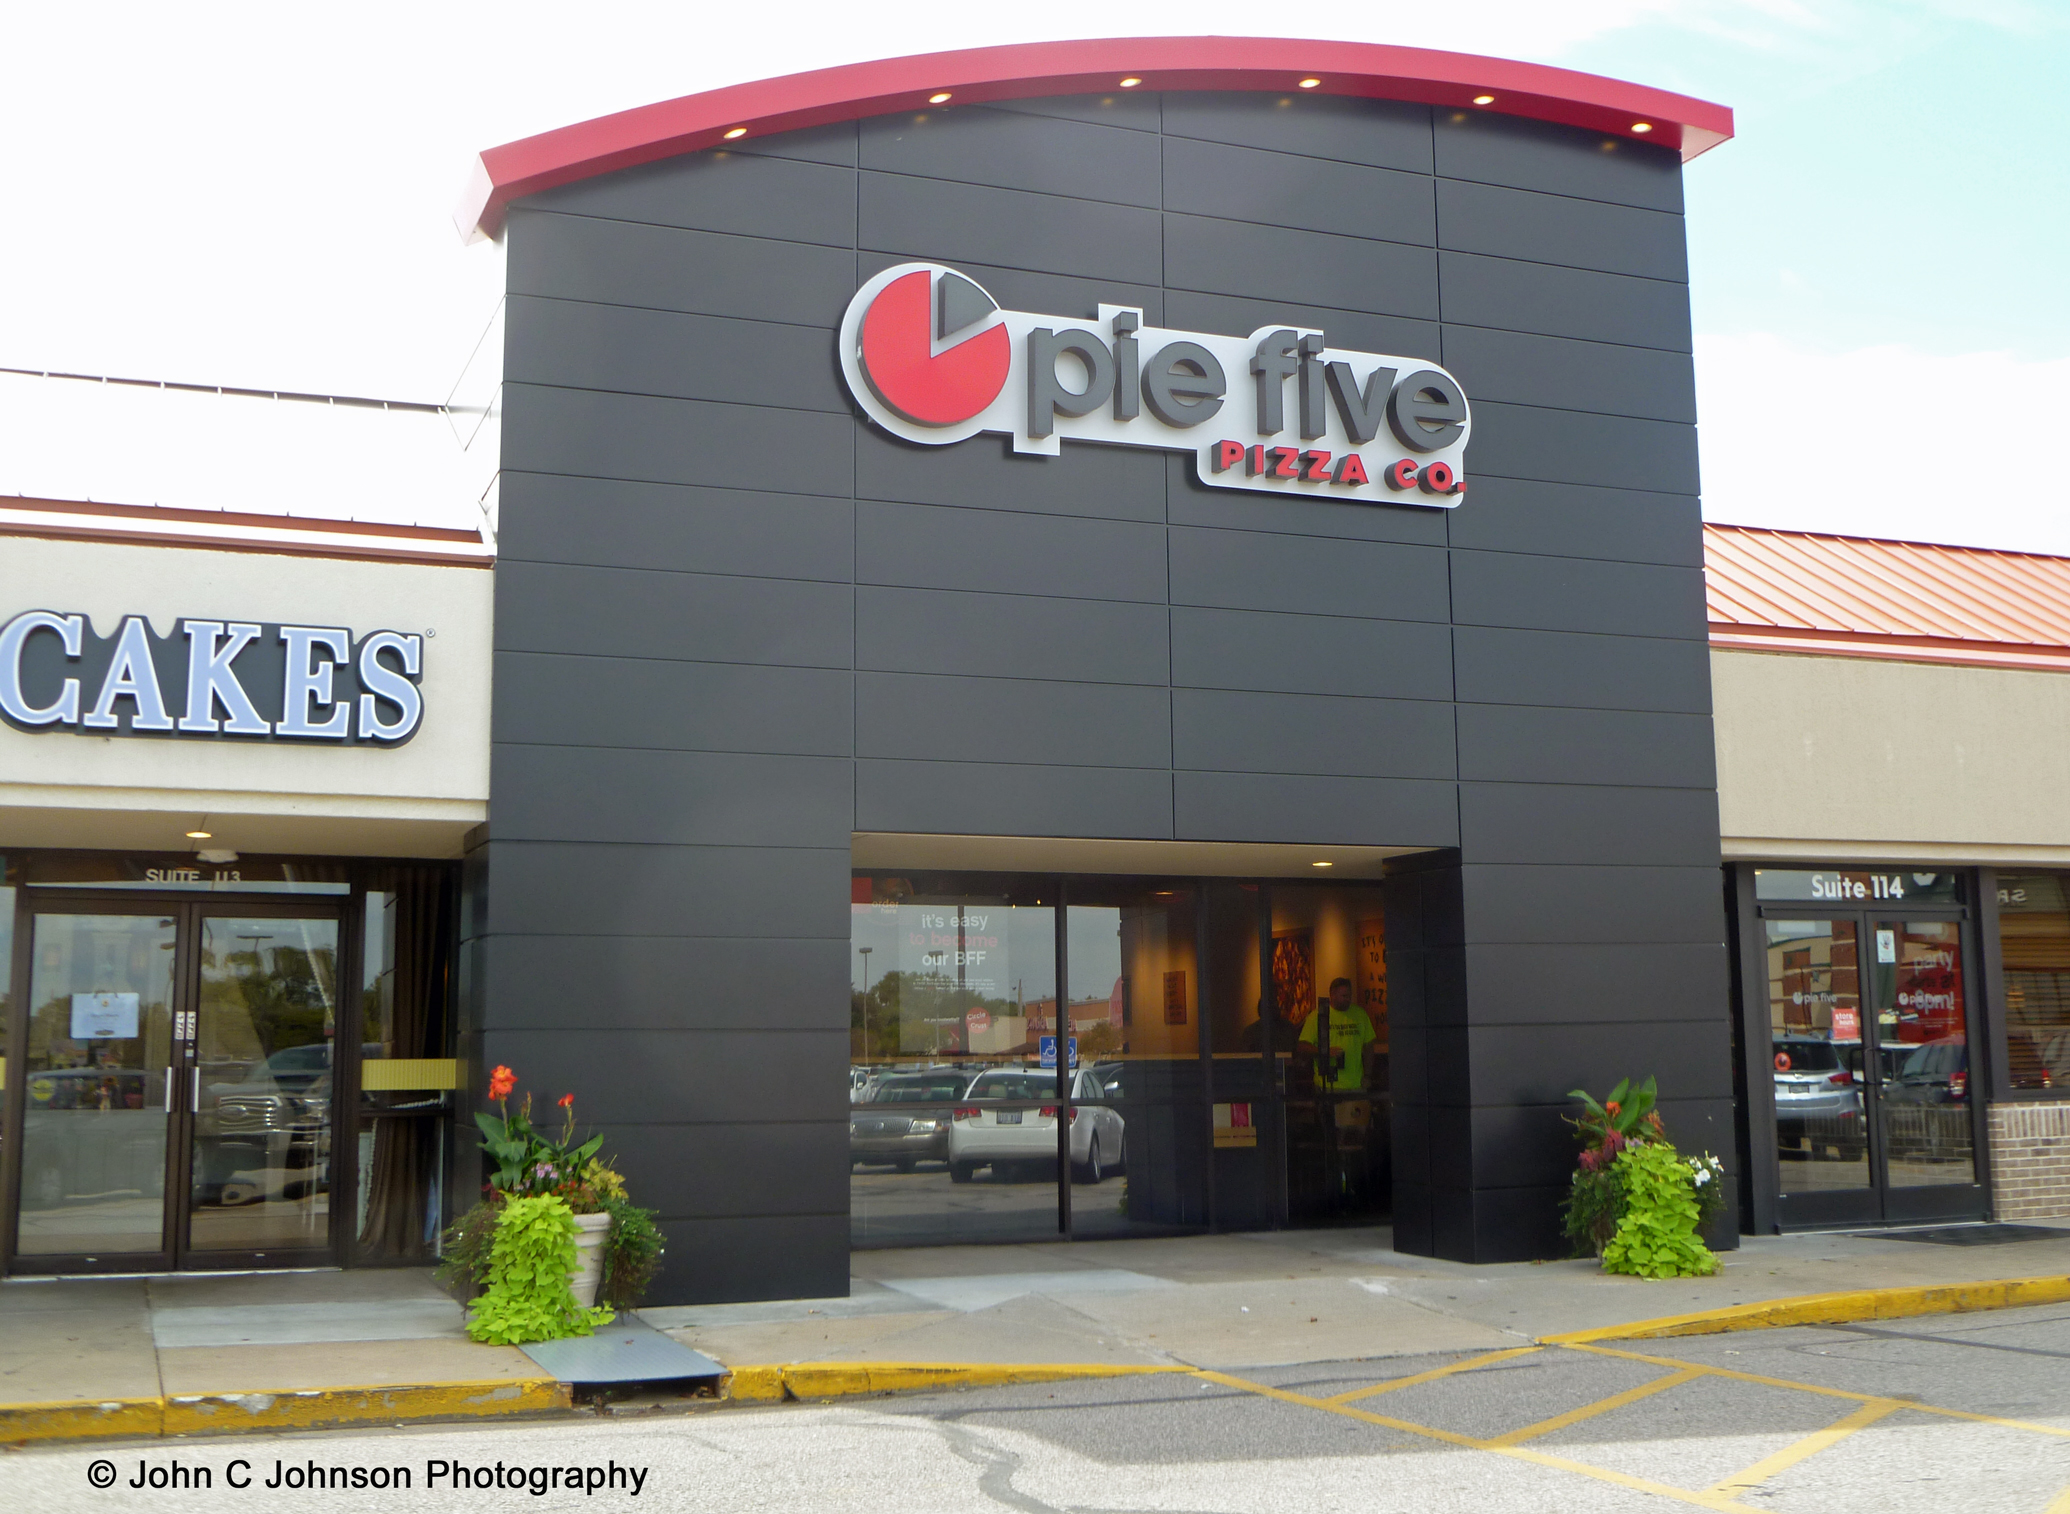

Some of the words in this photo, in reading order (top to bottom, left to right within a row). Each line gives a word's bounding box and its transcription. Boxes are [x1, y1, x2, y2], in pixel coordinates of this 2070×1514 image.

[1027, 311, 1227, 439] pie
[1250, 329, 1467, 453] five
[1211, 439, 1369, 487] PIZZA
[1384, 458, 1467, 496] CO.
[0, 610, 422, 741] CAKES
[145, 868, 200, 884] SUITE
[1811, 874, 1867, 898] Suite
[1870, 875, 1905, 898] 114
[922, 914, 944, 928] it's
[950, 915, 988, 931] easy
[909, 932, 925, 945] to
[931, 931, 998, 947] become
[922, 954, 949, 966] our
[954, 951, 987, 966] BFF
[1913, 950, 1954, 976] party
[967, 1012, 986, 1020] Circle
